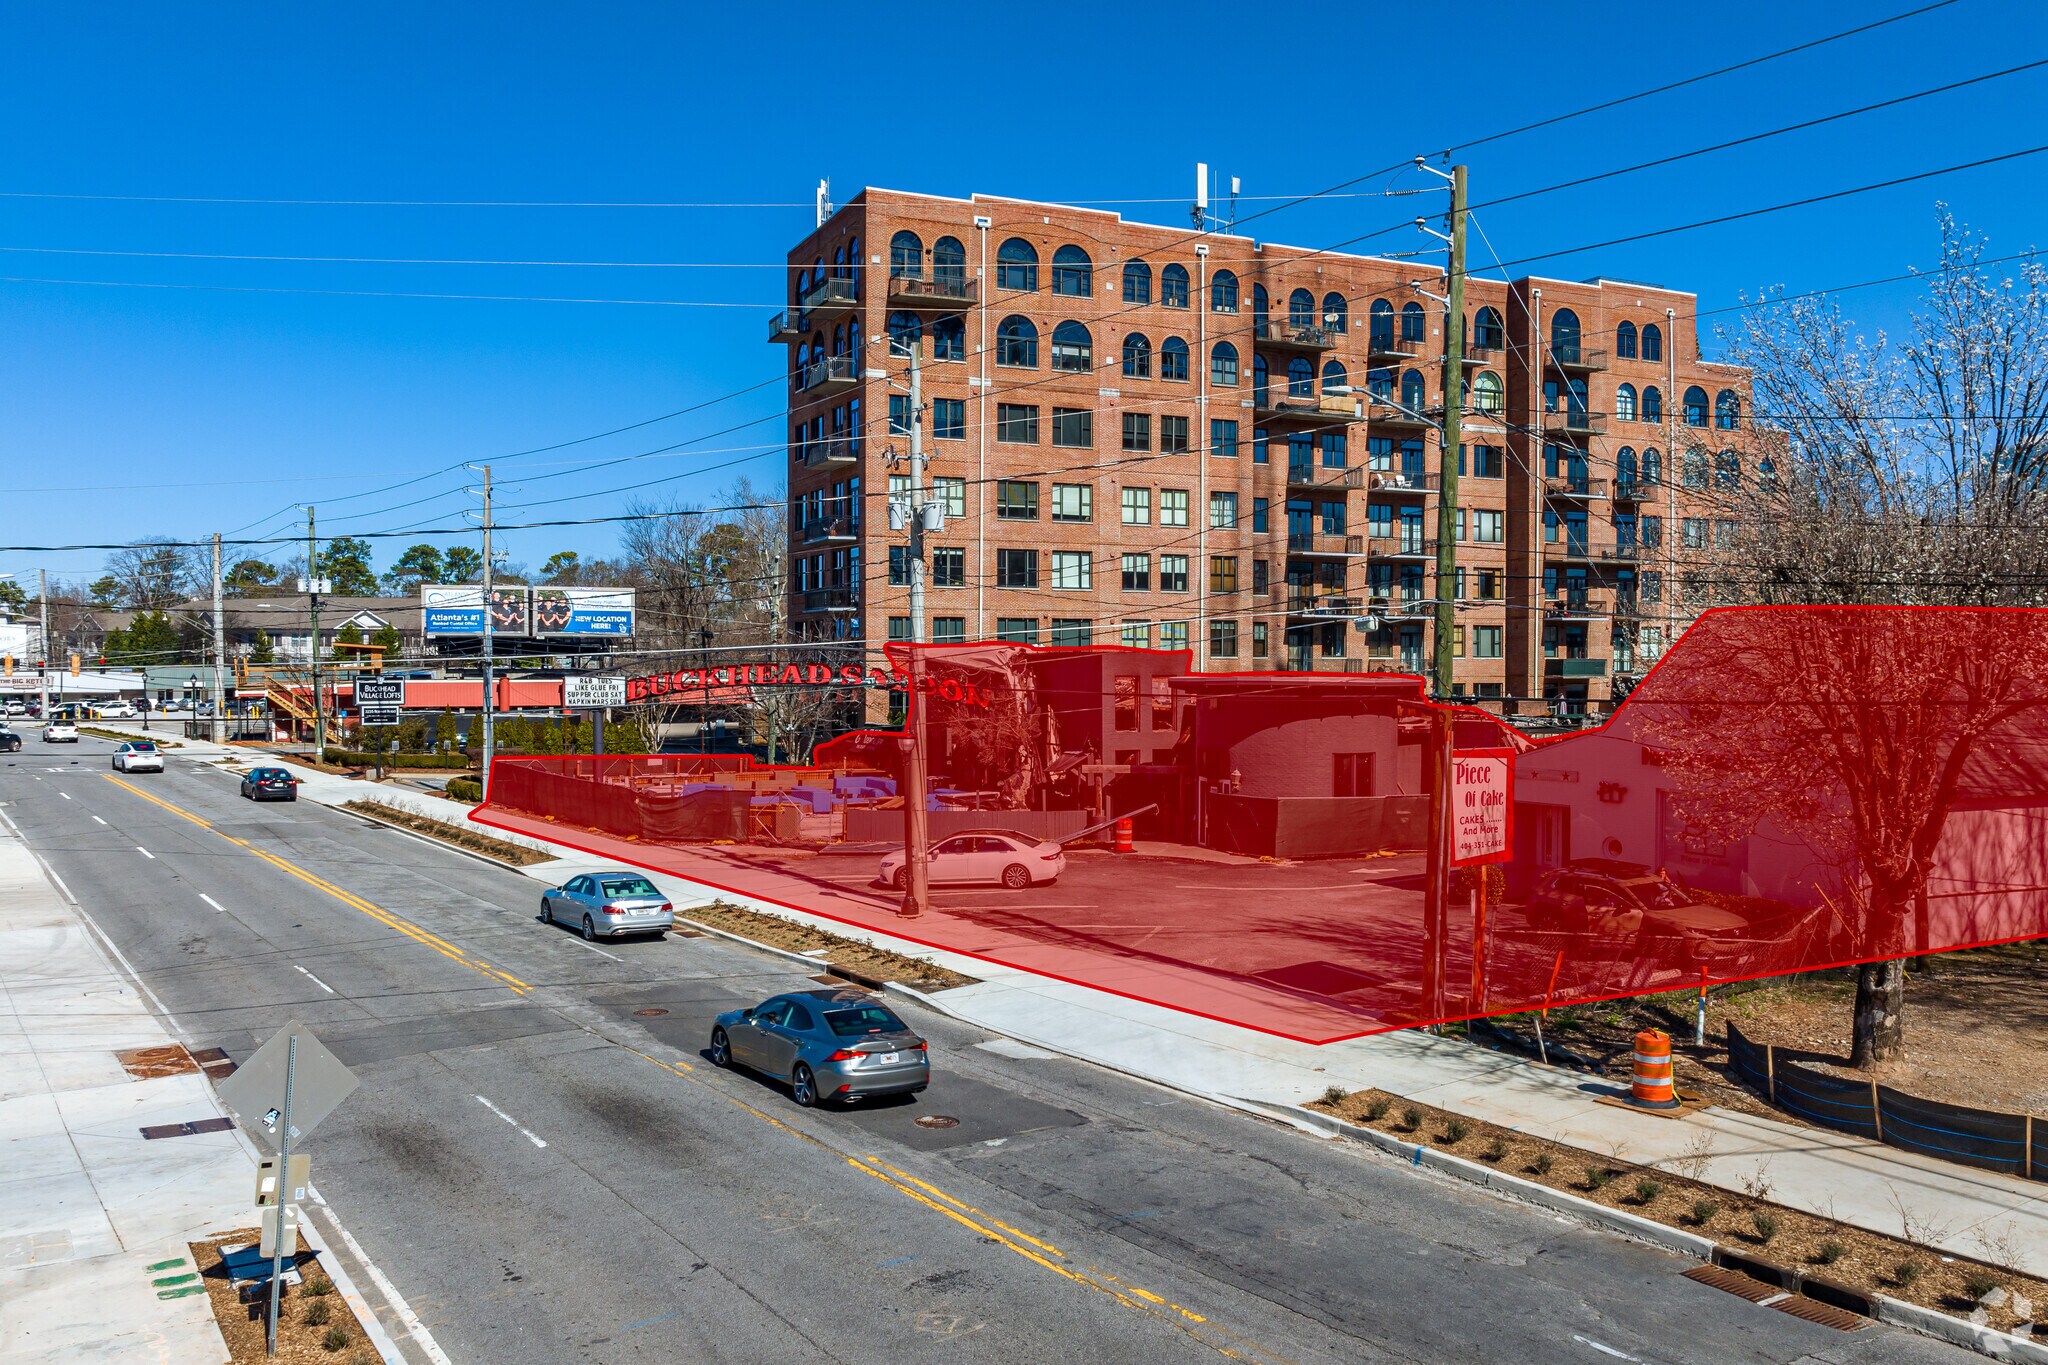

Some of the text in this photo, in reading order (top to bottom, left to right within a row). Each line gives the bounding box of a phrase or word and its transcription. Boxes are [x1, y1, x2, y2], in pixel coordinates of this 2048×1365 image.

[626, 662, 833, 701] BUCKHEAD
[1456, 763, 1491, 785] Piece
[1465, 789, 1504, 807] Of Cake
[1460, 815, 1484, 825] CAKES
[1463, 825, 1498, 836] And More
[1460, 840, 1502, 850] 404-351-CAKE
